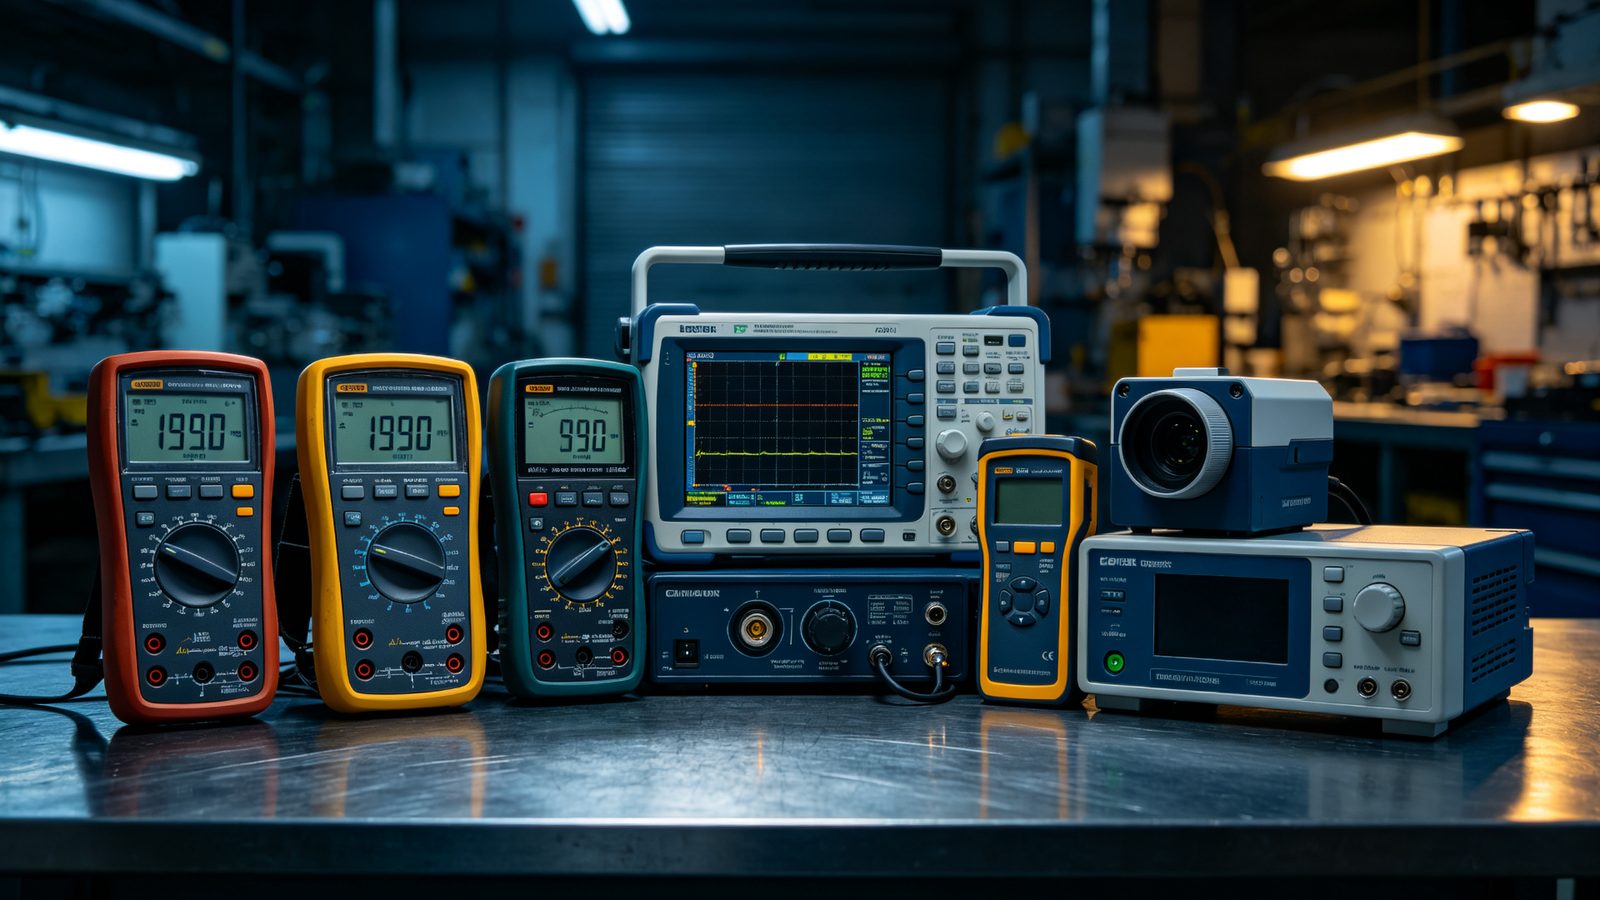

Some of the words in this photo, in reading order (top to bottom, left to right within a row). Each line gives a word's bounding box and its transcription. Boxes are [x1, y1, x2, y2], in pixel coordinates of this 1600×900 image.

[158, 413, 225, 450] 1990
[369, 415, 432, 451] 1990
[560, 419, 606, 452] 990
